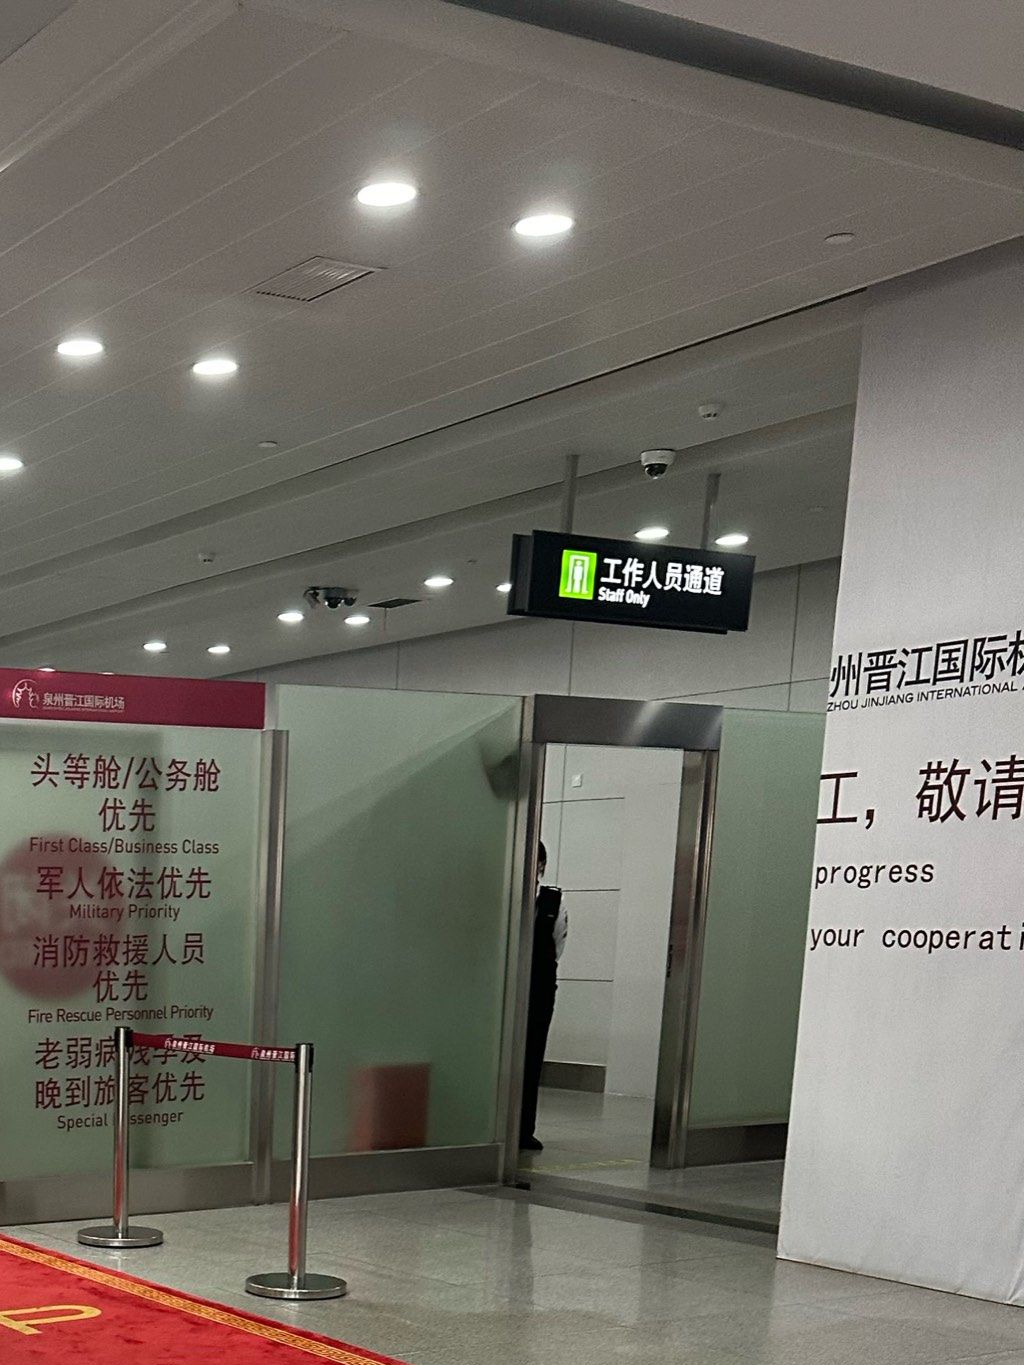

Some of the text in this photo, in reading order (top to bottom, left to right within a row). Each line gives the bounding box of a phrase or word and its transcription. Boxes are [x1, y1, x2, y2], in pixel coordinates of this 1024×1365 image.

[600, 557, 725, 596] 工作人员通道
[598, 586, 651, 608] Staff Only
[43, 692, 125, 709] 泉州晋江国际机场
[826, 699, 859, 712] ZHOU
[861, 693, 914, 709] JINJIANG
[916, 681, 1018, 702] INTERNATIONAL
[30, 752, 221, 792] 头等舱/公务舱
[98, 797, 157, 833] 优先
[30, 837, 220, 855] First Class/Business Class
[36, 866, 212, 900] 军人依法优先
[814, 863, 935, 889] progress
[69, 904, 180, 922] Military Priority
[33, 932, 205, 968] 消防救援人员
[810, 922, 1024, 954] your cooperati
[93, 969, 149, 1003] 优先
[28, 1005, 214, 1024] Fire Rescue Personnel Priority
[35, 1070, 205, 1110] 晚到旅客优先
[57, 1111, 184, 1132] Special ssenger
